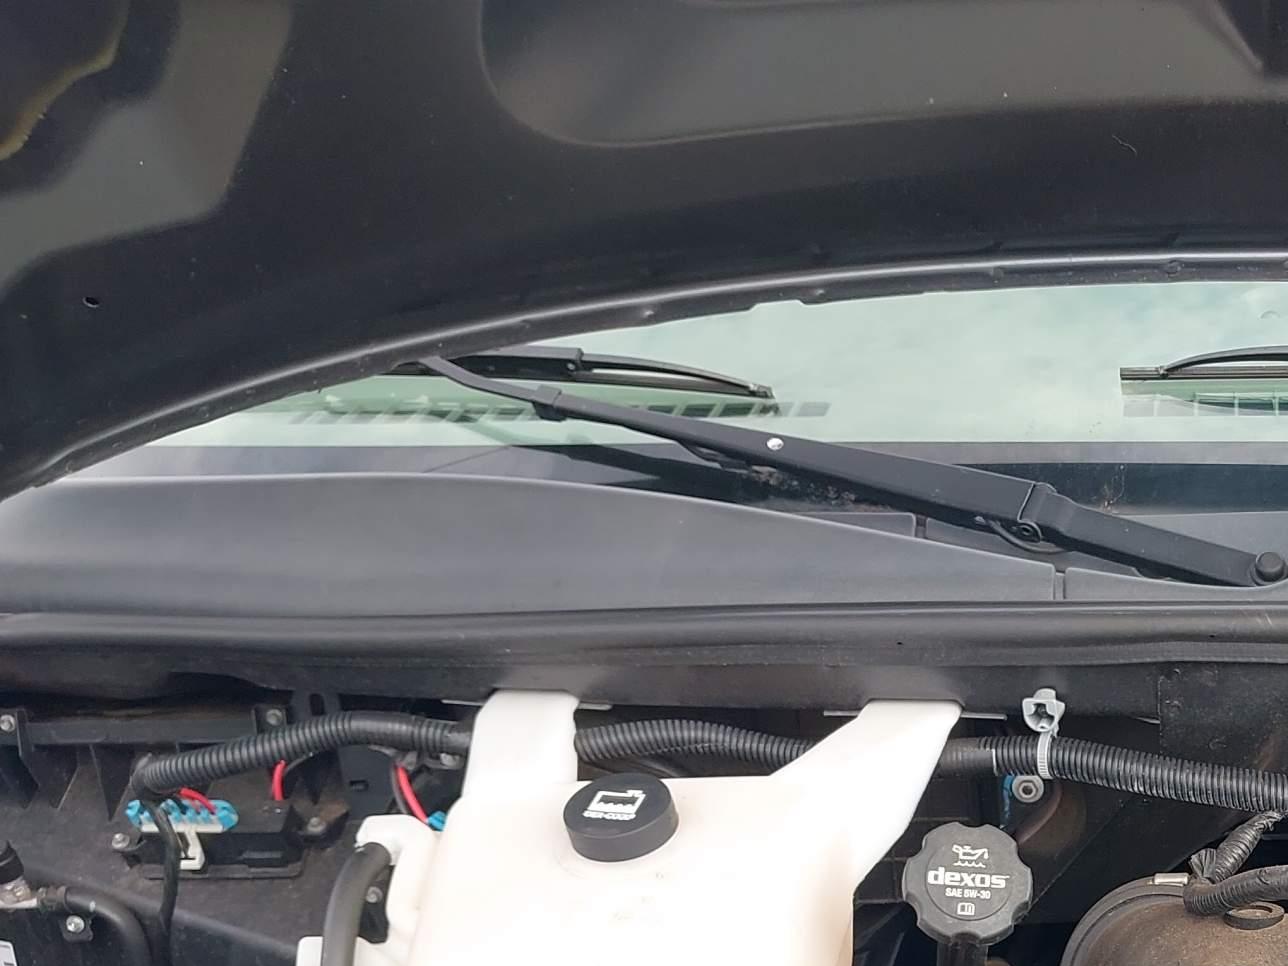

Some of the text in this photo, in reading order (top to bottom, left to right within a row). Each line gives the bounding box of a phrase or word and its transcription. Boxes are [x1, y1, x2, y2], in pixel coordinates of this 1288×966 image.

[928, 866, 1010, 888] dexos
[945, 888, 991, 899] SAE 5W-30
